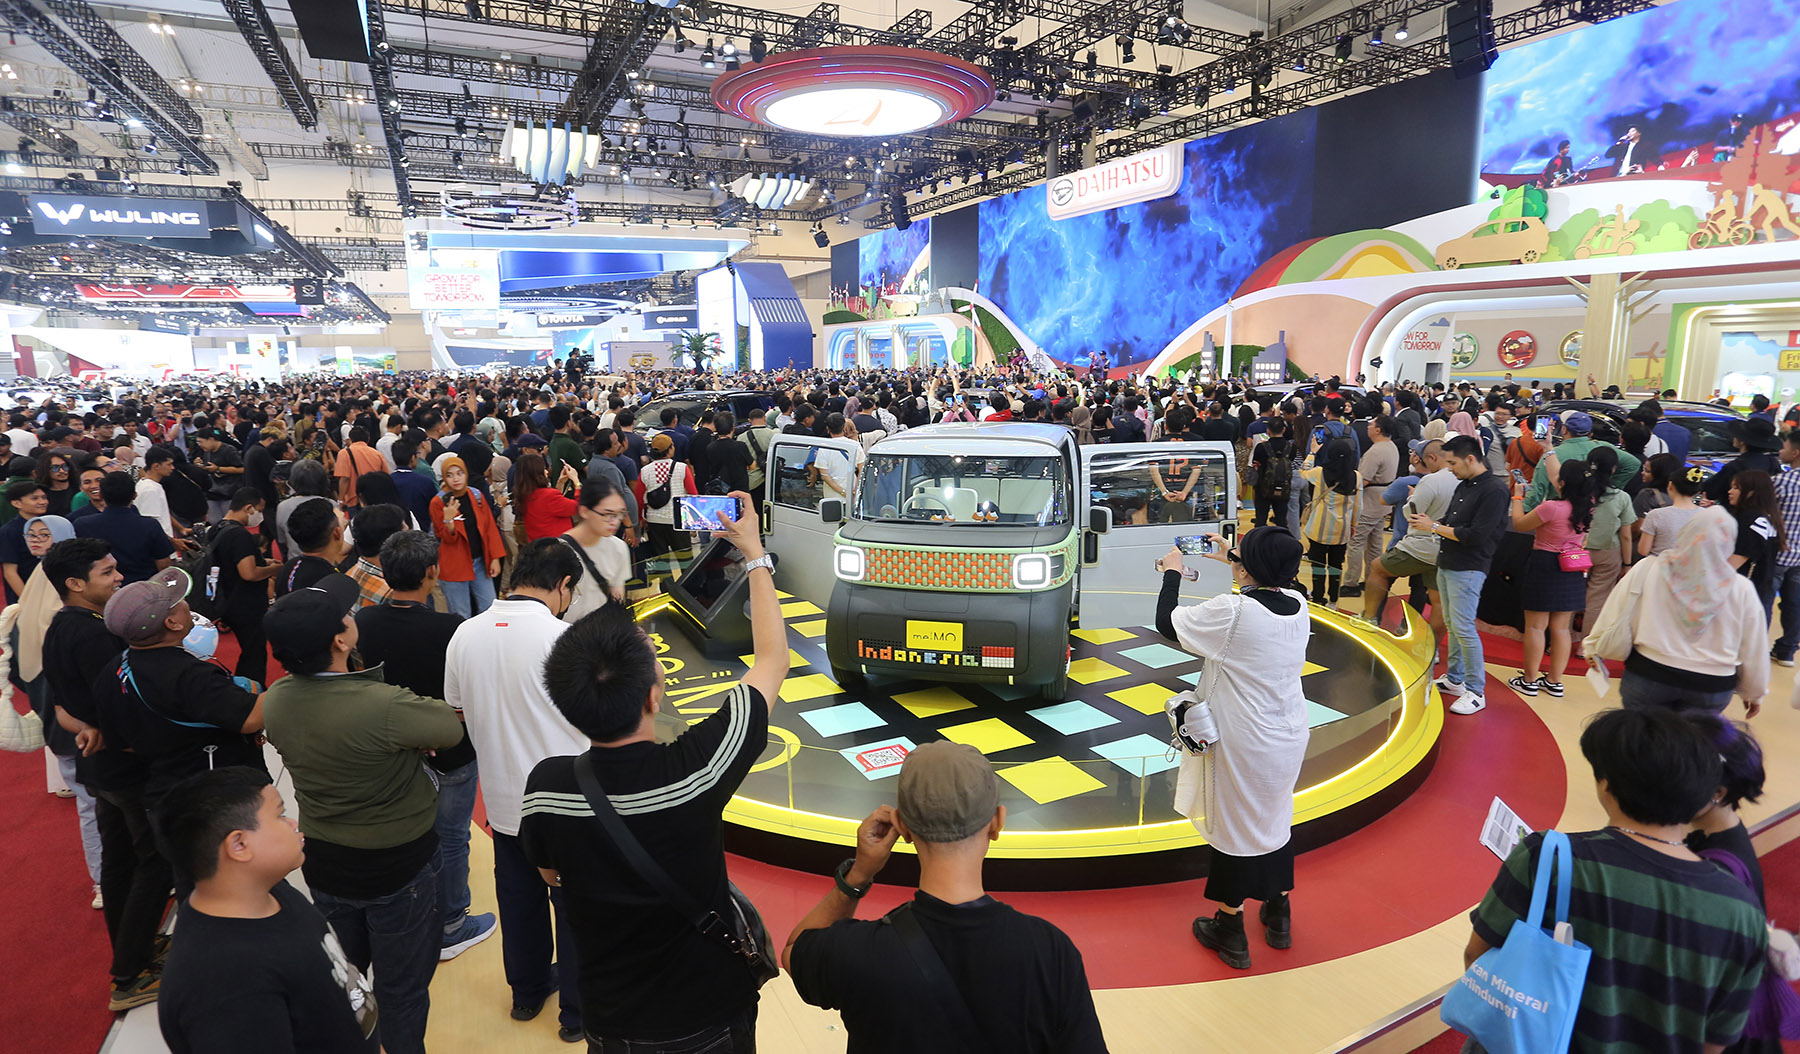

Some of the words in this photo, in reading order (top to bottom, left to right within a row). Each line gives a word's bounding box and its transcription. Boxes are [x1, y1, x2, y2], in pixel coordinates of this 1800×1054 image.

[1078, 154, 1164, 198] DAIHATSU
[88, 208, 201, 226] WULING
[424, 273, 457, 283] GROW
[460, 274, 481, 284] FOR
[435, 283, 472, 293] BETTER
[423, 292, 485, 302] TOMORROW
[548, 314, 585, 324] TOYOTA
[1414, 331, 1429, 341] FOR
[1403, 340, 1442, 351] TOMORROW
[1490, 973, 1549, 1014] Mineral
